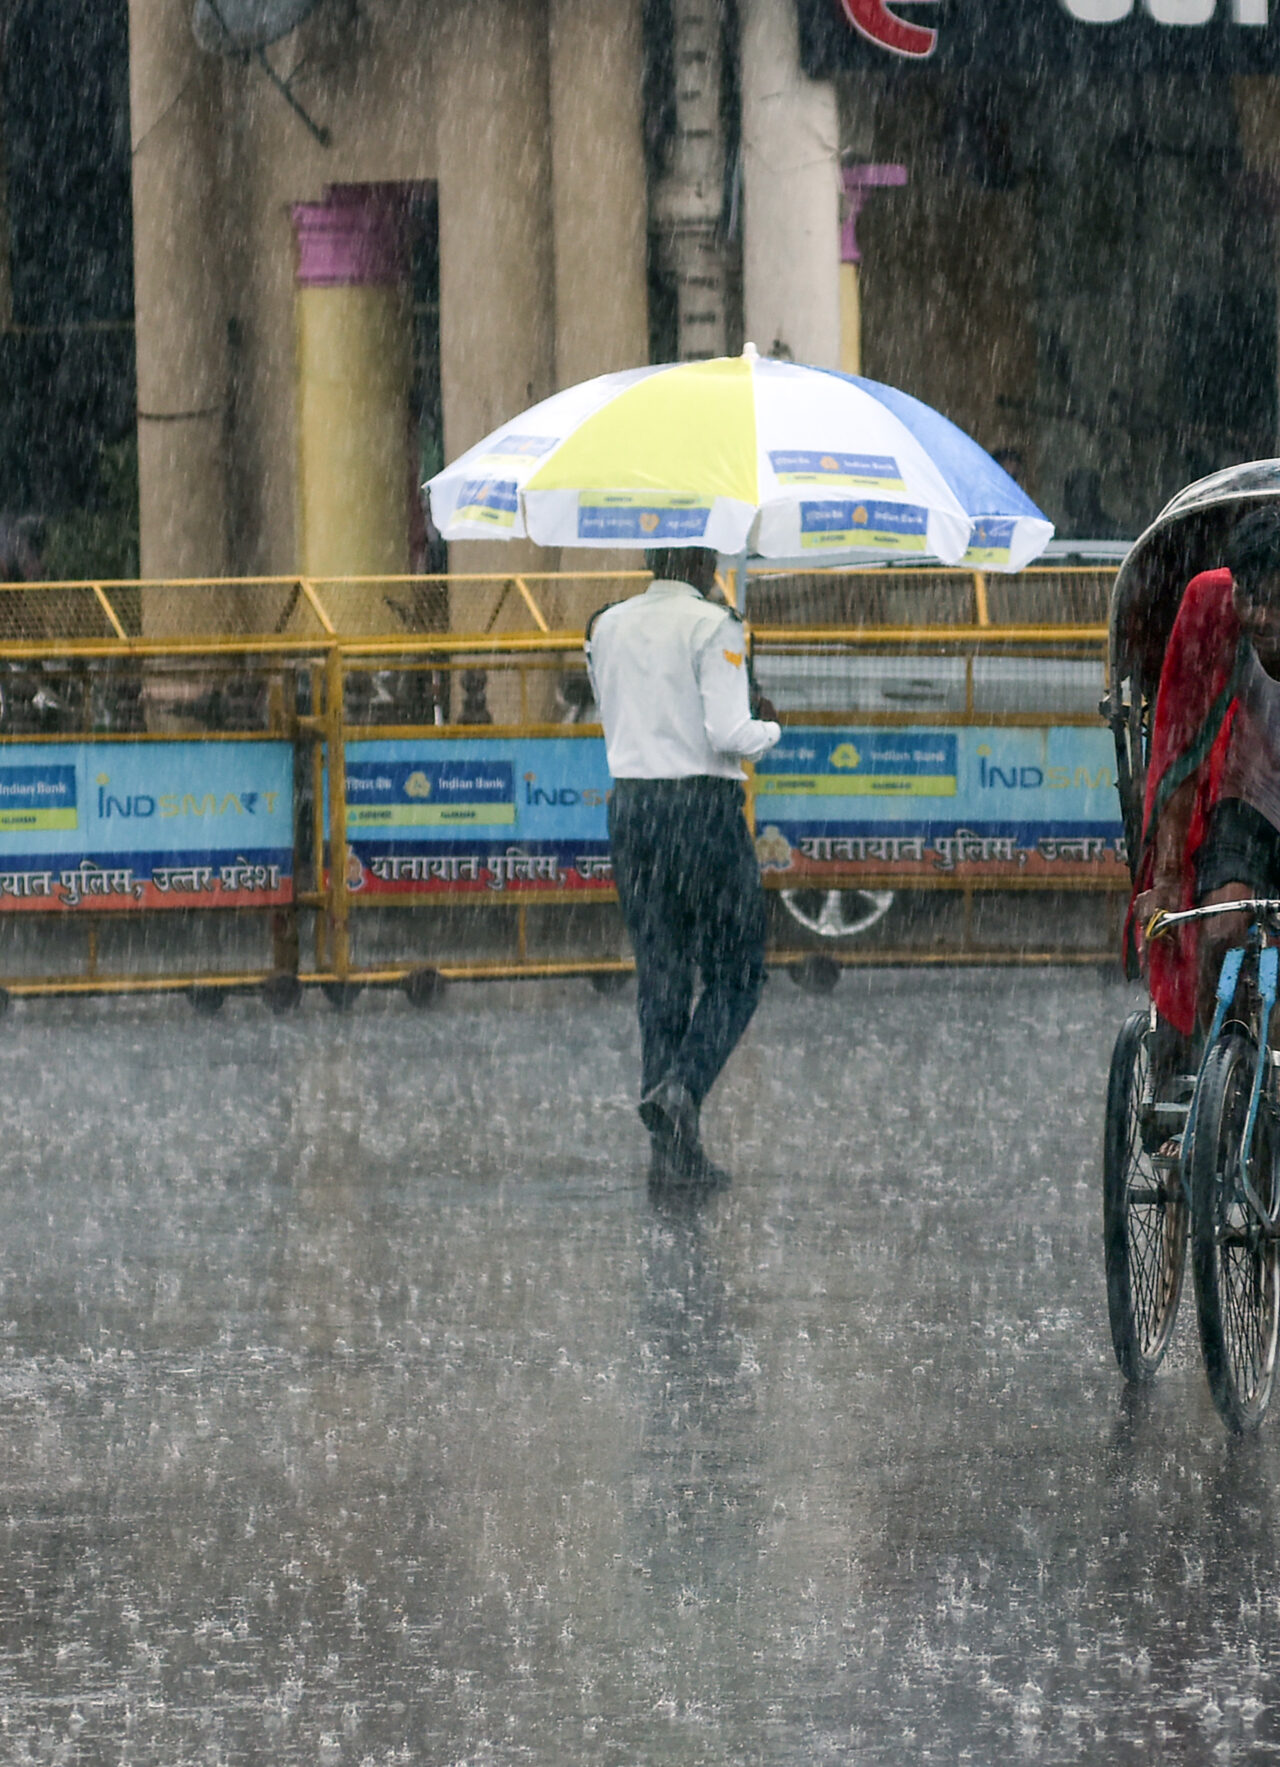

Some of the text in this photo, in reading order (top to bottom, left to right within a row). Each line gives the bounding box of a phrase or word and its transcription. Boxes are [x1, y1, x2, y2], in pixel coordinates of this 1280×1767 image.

[37, 781, 66, 794] Bank
[439, 777, 504, 790] Indian Bank
[800, 837, 927, 861] यातायात
[151, 866, 213, 892] उत्तर
[219, 856, 280, 891] प्रदेश
[371, 856, 479, 881] यातायात
